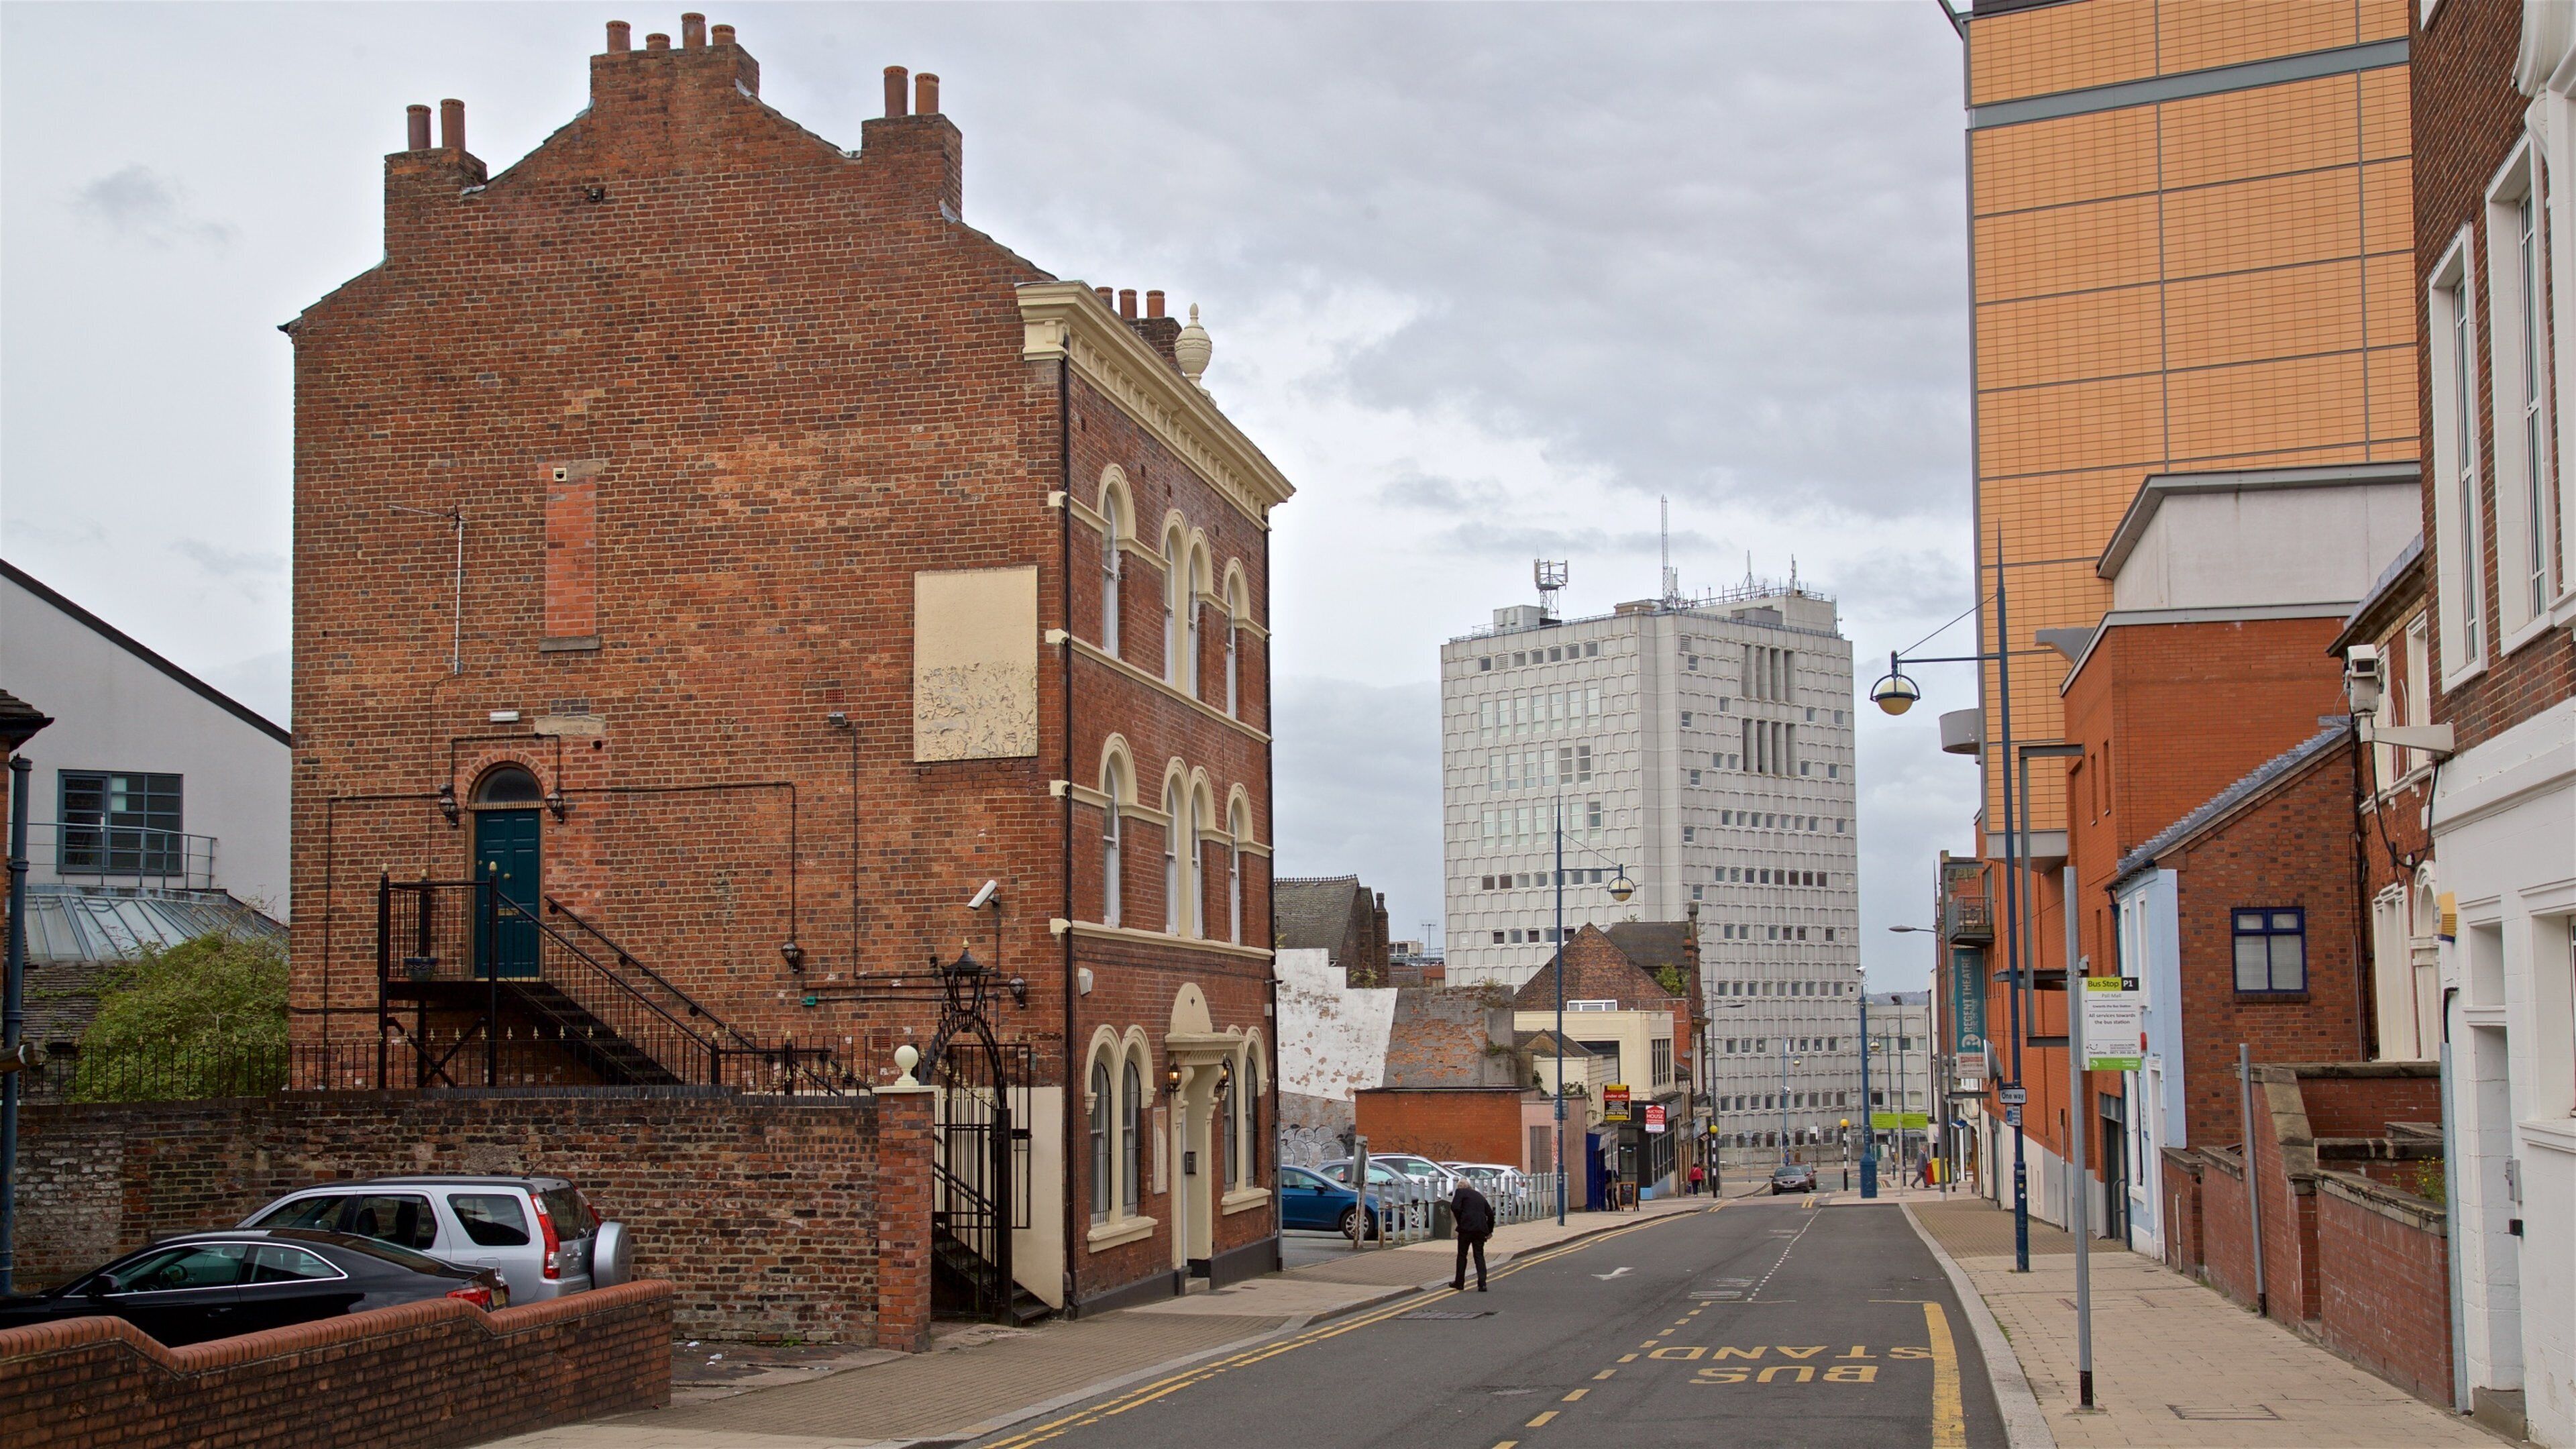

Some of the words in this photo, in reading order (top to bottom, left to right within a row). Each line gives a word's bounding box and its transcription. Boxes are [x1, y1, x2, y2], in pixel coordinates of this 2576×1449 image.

[1962, 957, 1972, 997] THEATRE
[1963, 998, 1973, 1032] REGENT
[1648, 1346, 1932, 1360] STAND
[1689, 1365, 1879, 1385] BUS
